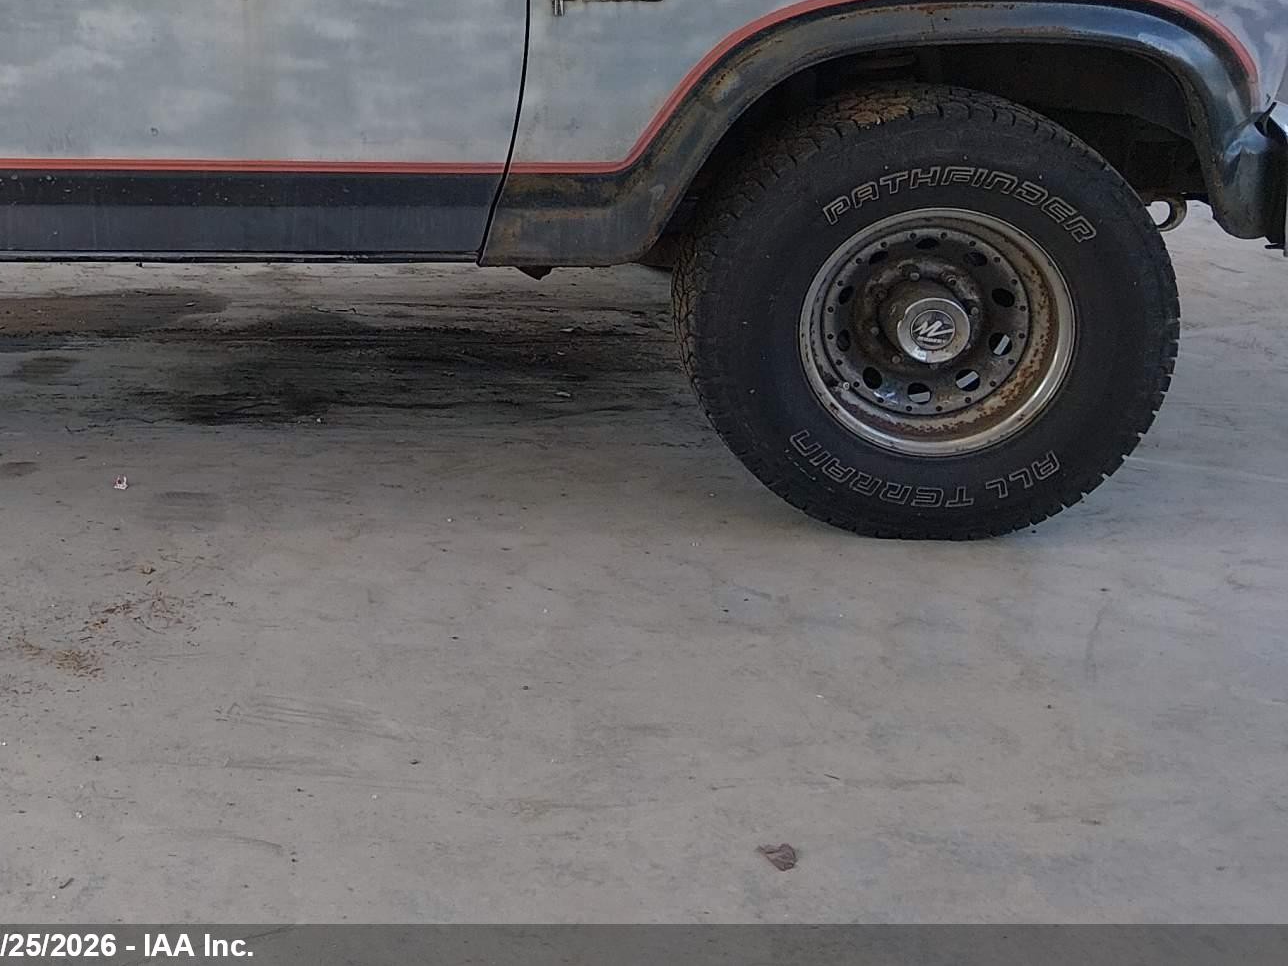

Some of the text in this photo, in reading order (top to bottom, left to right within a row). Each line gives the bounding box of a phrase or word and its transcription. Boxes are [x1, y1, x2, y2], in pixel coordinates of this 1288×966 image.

[822, 166, 1097, 243] PATHFINDER
[789, 429, 1061, 508] ALL TERRAIN
